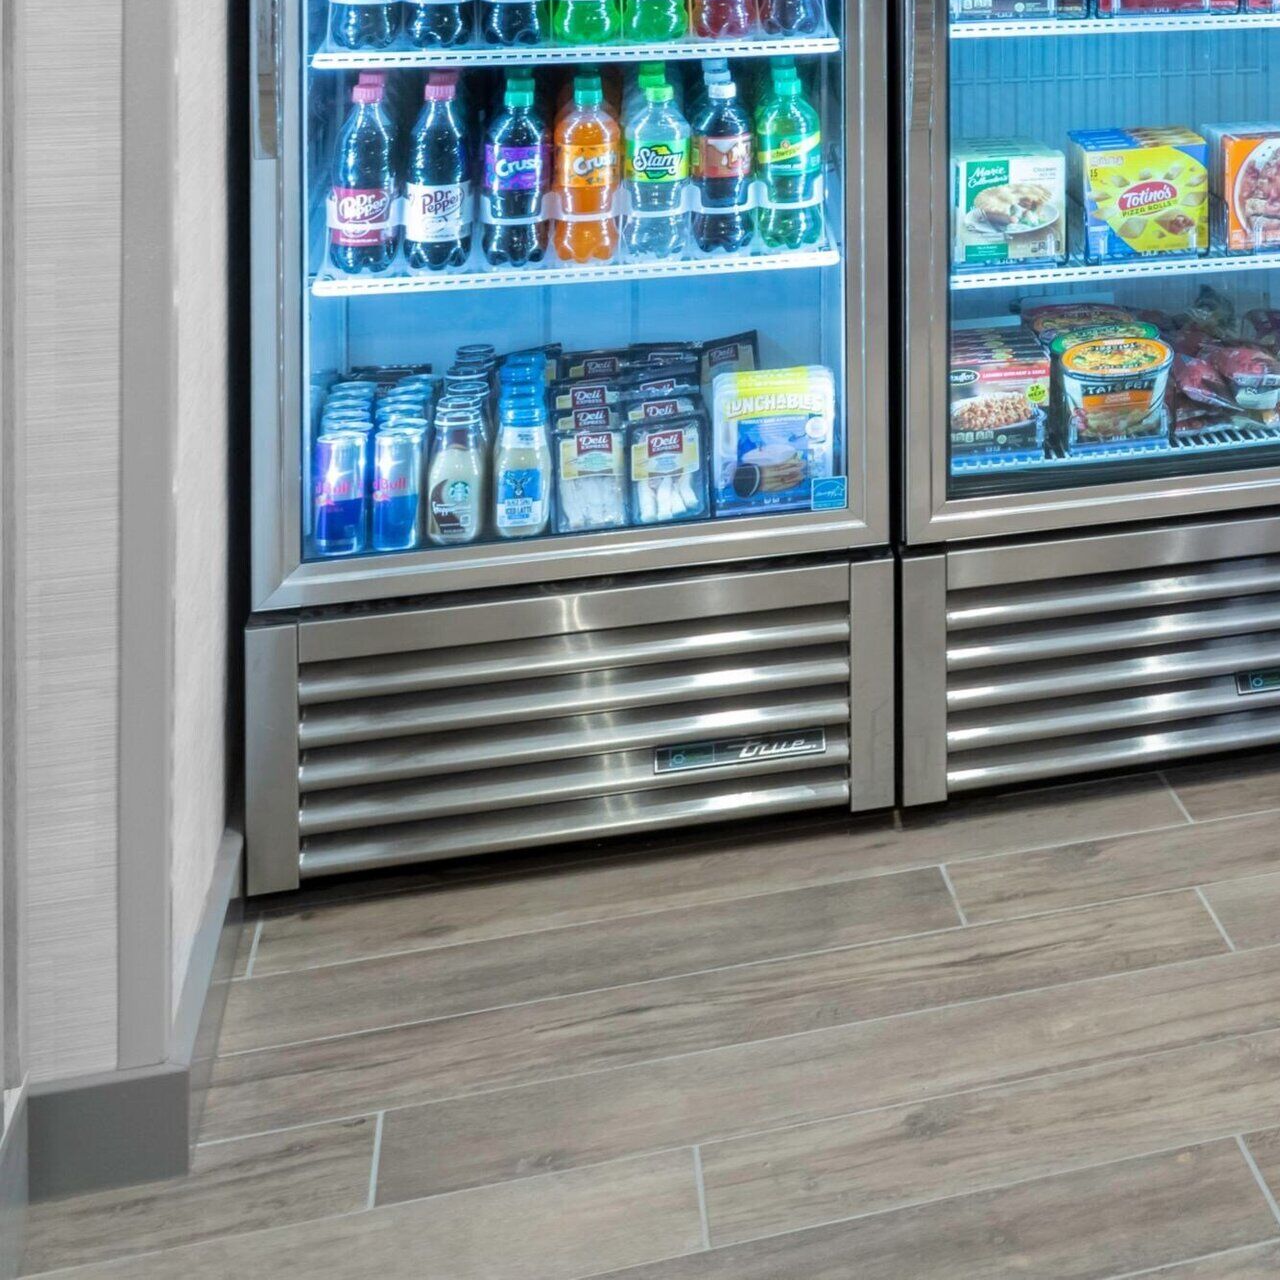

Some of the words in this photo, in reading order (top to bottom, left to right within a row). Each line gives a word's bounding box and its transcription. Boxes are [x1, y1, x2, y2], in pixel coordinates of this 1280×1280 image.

[1125, 184, 1172, 209] Totino's
[422, 194, 464, 215] Pepper
[1122, 207, 1146, 218] PIZZA
[1146, 200, 1172, 211] ROLLS
[574, 389, 602, 401] Deli
[647, 405, 674, 417] Deli
[727, 394, 823, 418] LUNCHABLES
[577, 409, 605, 421] Deli
[579, 434, 608, 446] Deli
[651, 434, 680, 446] Deli
